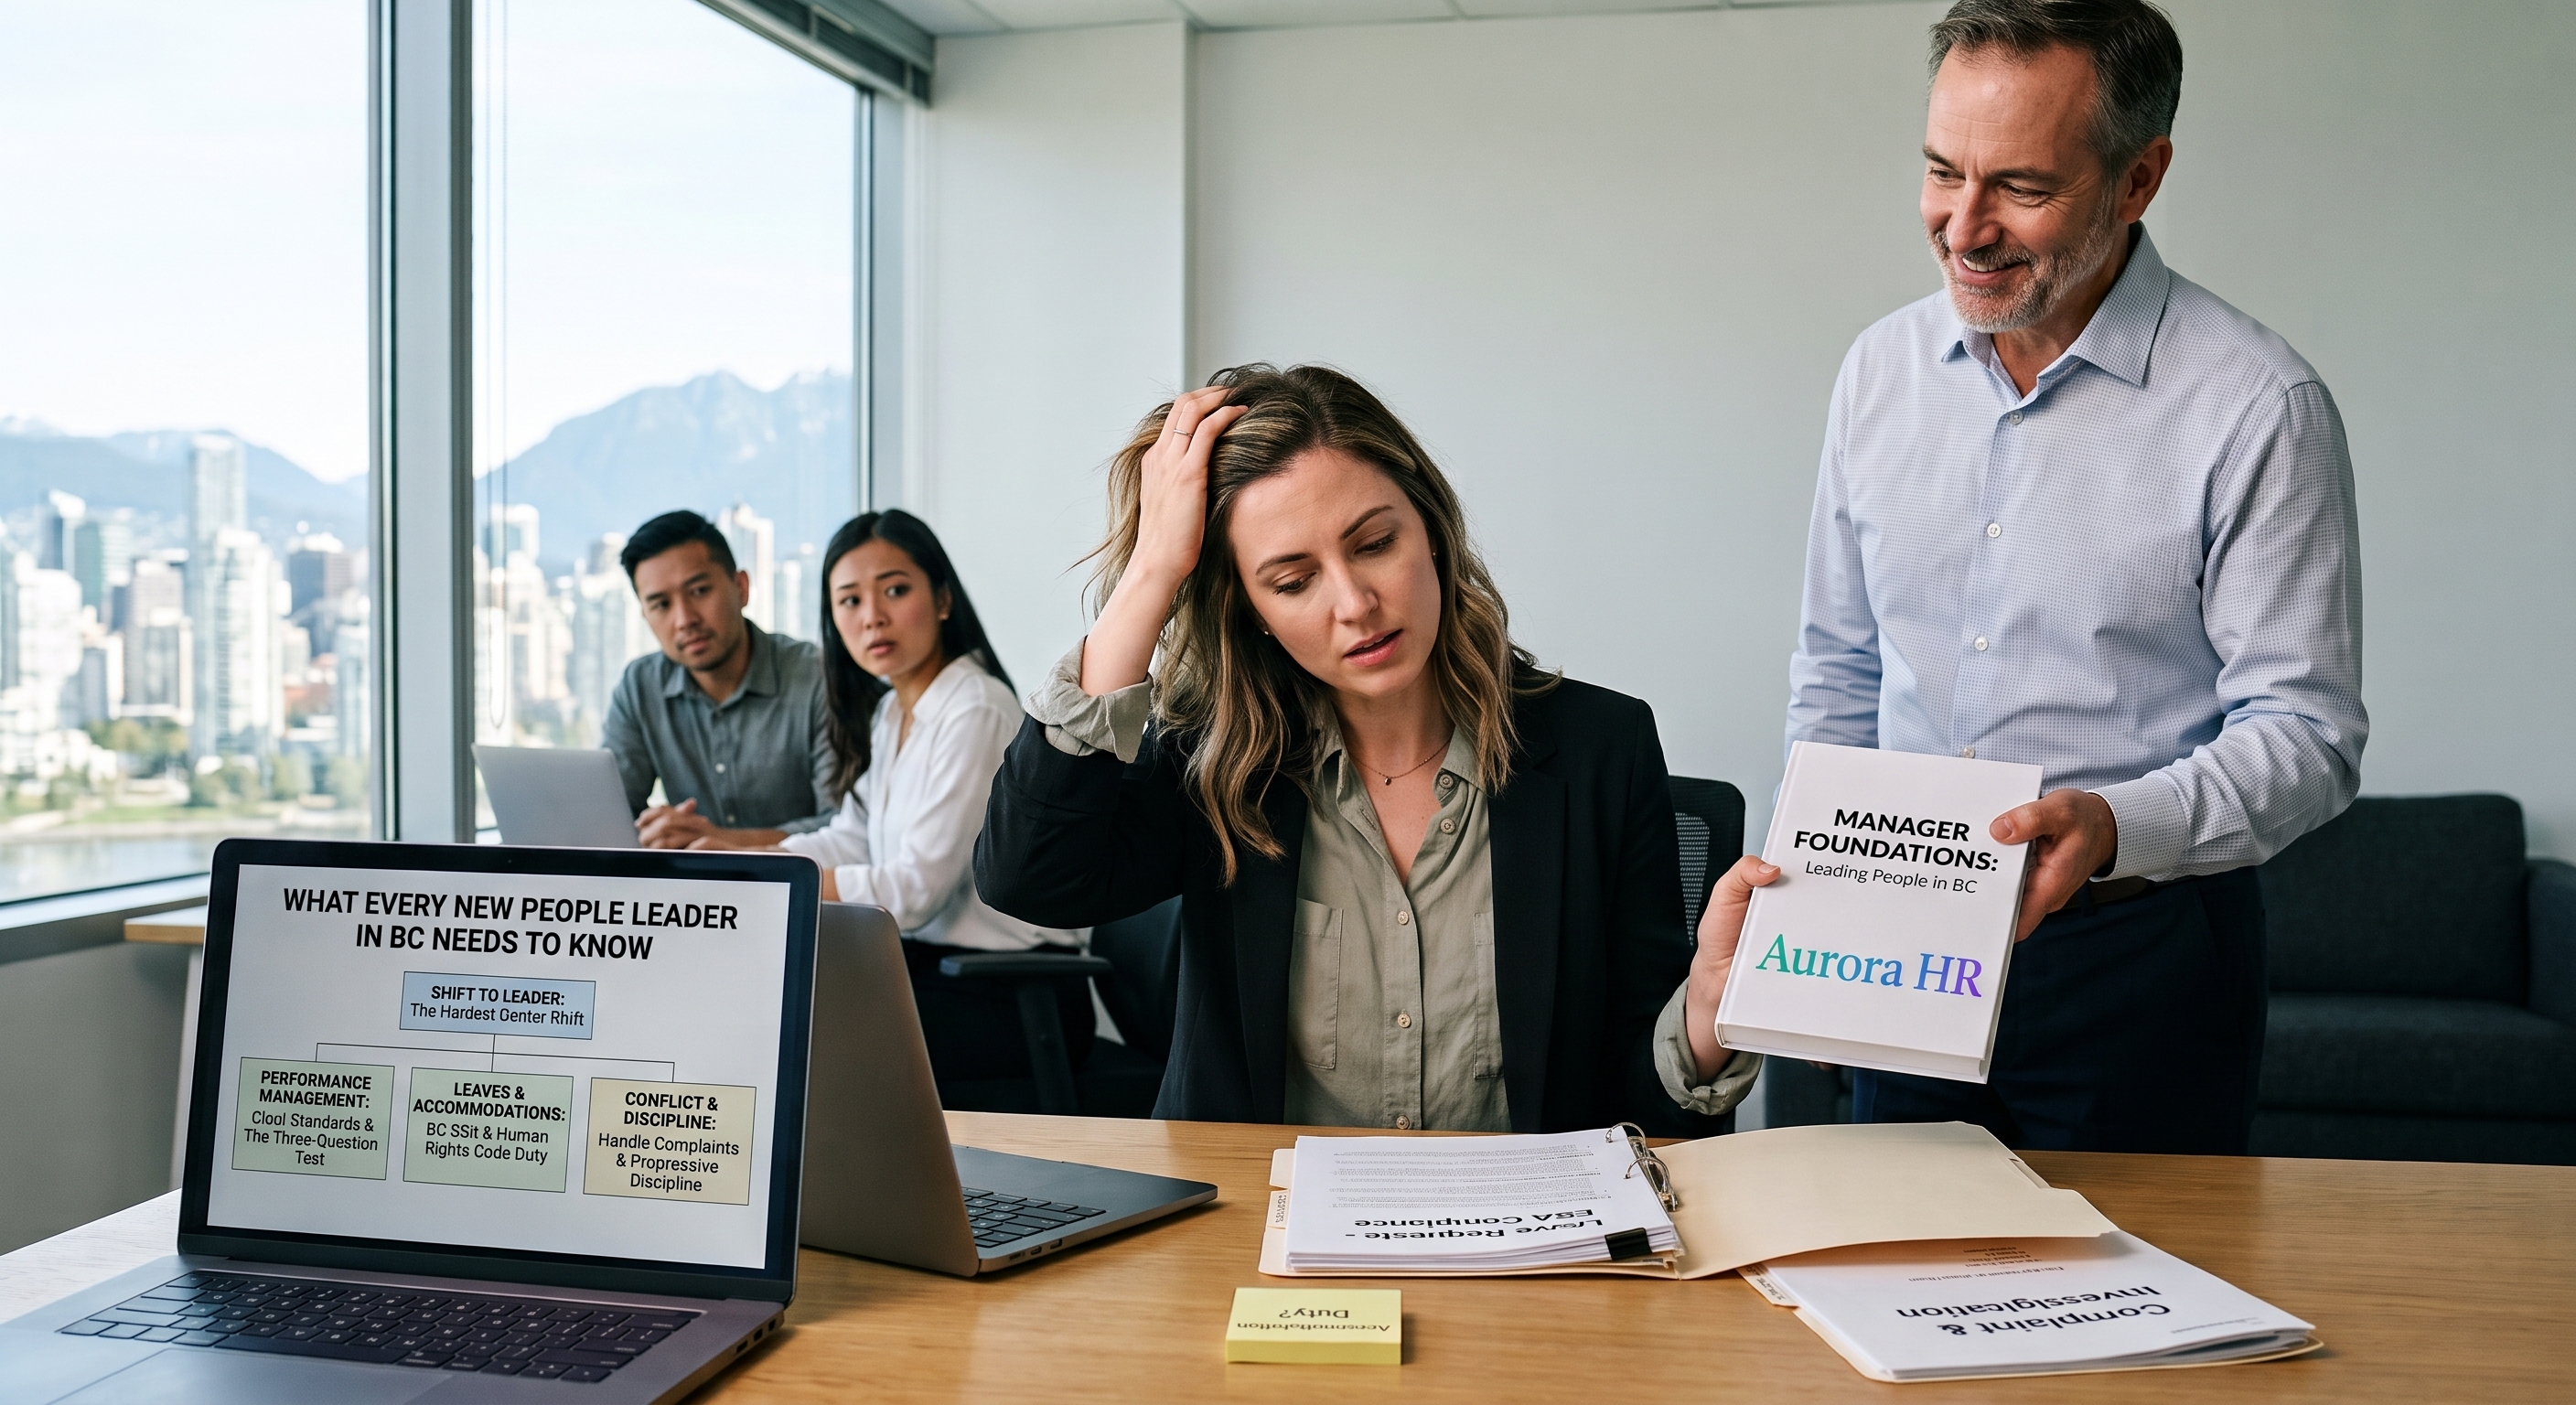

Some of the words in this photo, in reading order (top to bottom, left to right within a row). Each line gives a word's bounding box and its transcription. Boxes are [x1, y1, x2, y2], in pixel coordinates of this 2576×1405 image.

[1834, 809, 1970, 842] MANAGER
[1794, 831, 1999, 871] FOUNDATIONS:
[1806, 861, 1868, 883] Leading
[1873, 869, 1927, 887] People
[1933, 875, 1947, 889] in
[1953, 879, 1977, 893] BC
[284, 888, 359, 913] WHAT
[365, 892, 447, 917] EVERY
[455, 895, 514, 919] NEW
[521, 897, 624, 925] PEOPLE
[632, 902, 737, 929] LEADER
[357, 924, 382, 947] IN
[391, 926, 424, 949] BC
[433, 928, 518, 953] NEEDS
[526, 931, 561, 955] TO
[569, 933, 653, 960] KNOW
[1756, 934, 1902, 987] Aurora
[1914, 953, 1981, 997] HR
[431, 986, 476, 1001] SHIFT
[478, 988, 499, 1002] TO
[503, 990, 564, 1005] LEADER:
[411, 1003, 436, 1017] The
[441, 1005, 496, 1021] Hardest
[551, 1011, 584, 1025] Rhift
[262, 1070, 371, 1089] PERFORMANCE
[260, 1089, 369, 1108] MANAGEMENT:
[455, 1082, 510, 1099] LEAVES
[515, 1087, 524, 1099] &
[626, 1092, 703, 1110] CONFLICT
[707, 1097, 718, 1110] &
[413, 1099, 565, 1121] ACCOMMODATIONS:
[624, 1111, 715, 1130] DISCIPLINE:
[291, 1113, 360, 1131] Standards
[365, 1119, 373, 1132] &
[427, 1122, 446, 1136] BC
[451, 1124, 478, 1139] SSit
[483, 1126, 492, 1140] &
[497, 1127, 548, 1143] Human
[244, 1129, 269, 1142] The
[274, 1131, 377, 1150] Three-Question
[599, 1133, 649, 1149] Handle
[655, 1137, 739, 1155] Complaints
[295, 1151, 325, 1165] Test
[425, 1142, 469, 1158] Rights
[475, 1144, 510, 1159] Code
[515, 1147, 548, 1165] Duty
[617, 1153, 626, 1166] &
[631, 1154, 718, 1173] Propressive
[631, 1174, 702, 1193] Discipline
[1279, 1308, 1348, 1318] Duty?
[1979, 1303, 2171, 1334] Complaint
[1937, 1325, 1967, 1335] &
